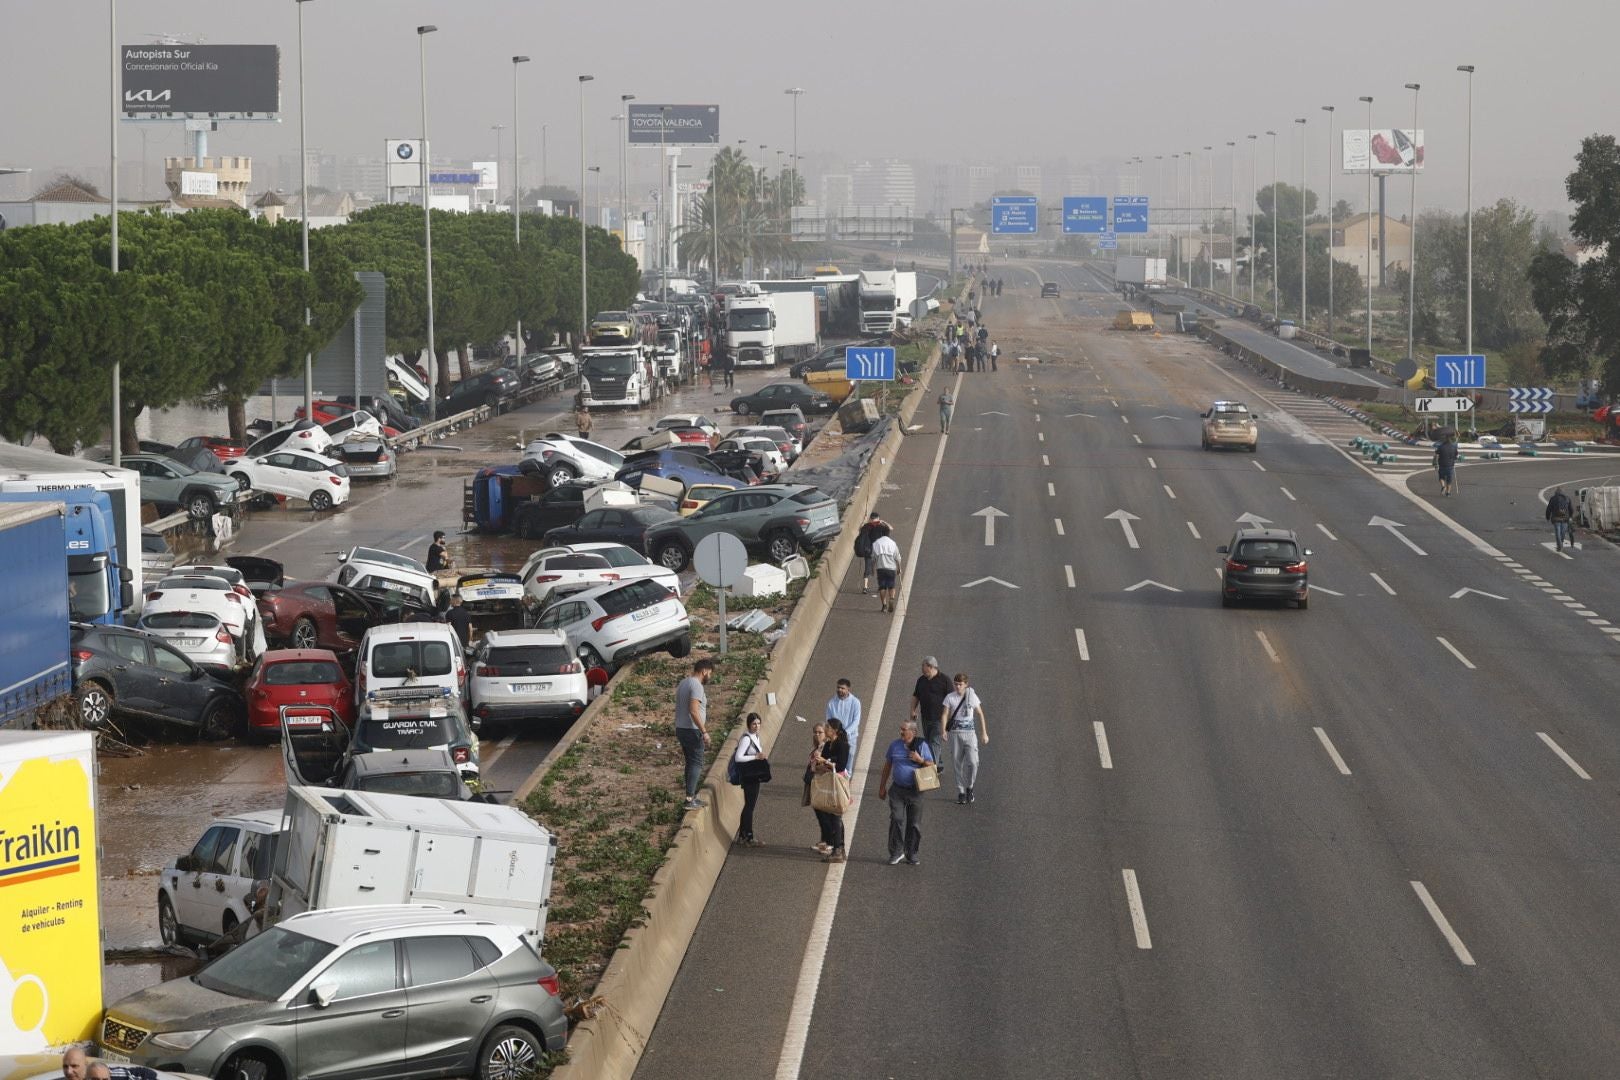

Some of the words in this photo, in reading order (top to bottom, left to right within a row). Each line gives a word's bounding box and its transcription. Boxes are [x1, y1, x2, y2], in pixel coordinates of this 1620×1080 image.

[125, 49, 172, 60] Autopista
[174, 49, 191, 59] Sur
[125, 62, 178, 71] Concesionario
[180, 62, 205, 71] Oficial
[206, 62, 218, 71] Kia
[125, 89, 172, 102] KIA
[632, 119, 662, 128] TOYOTA
[664, 119, 703, 128] VALENCIA
[1455, 399, 1467, 410] 11
[383, 721, 418, 729] GUARDIA
[419, 720, 438, 728] CIVIL
[0, 820, 80, 863] raikin
[21, 906, 49, 919] Alquiler
[56, 898, 83, 911] Renting
[21, 923, 31, 933] de
